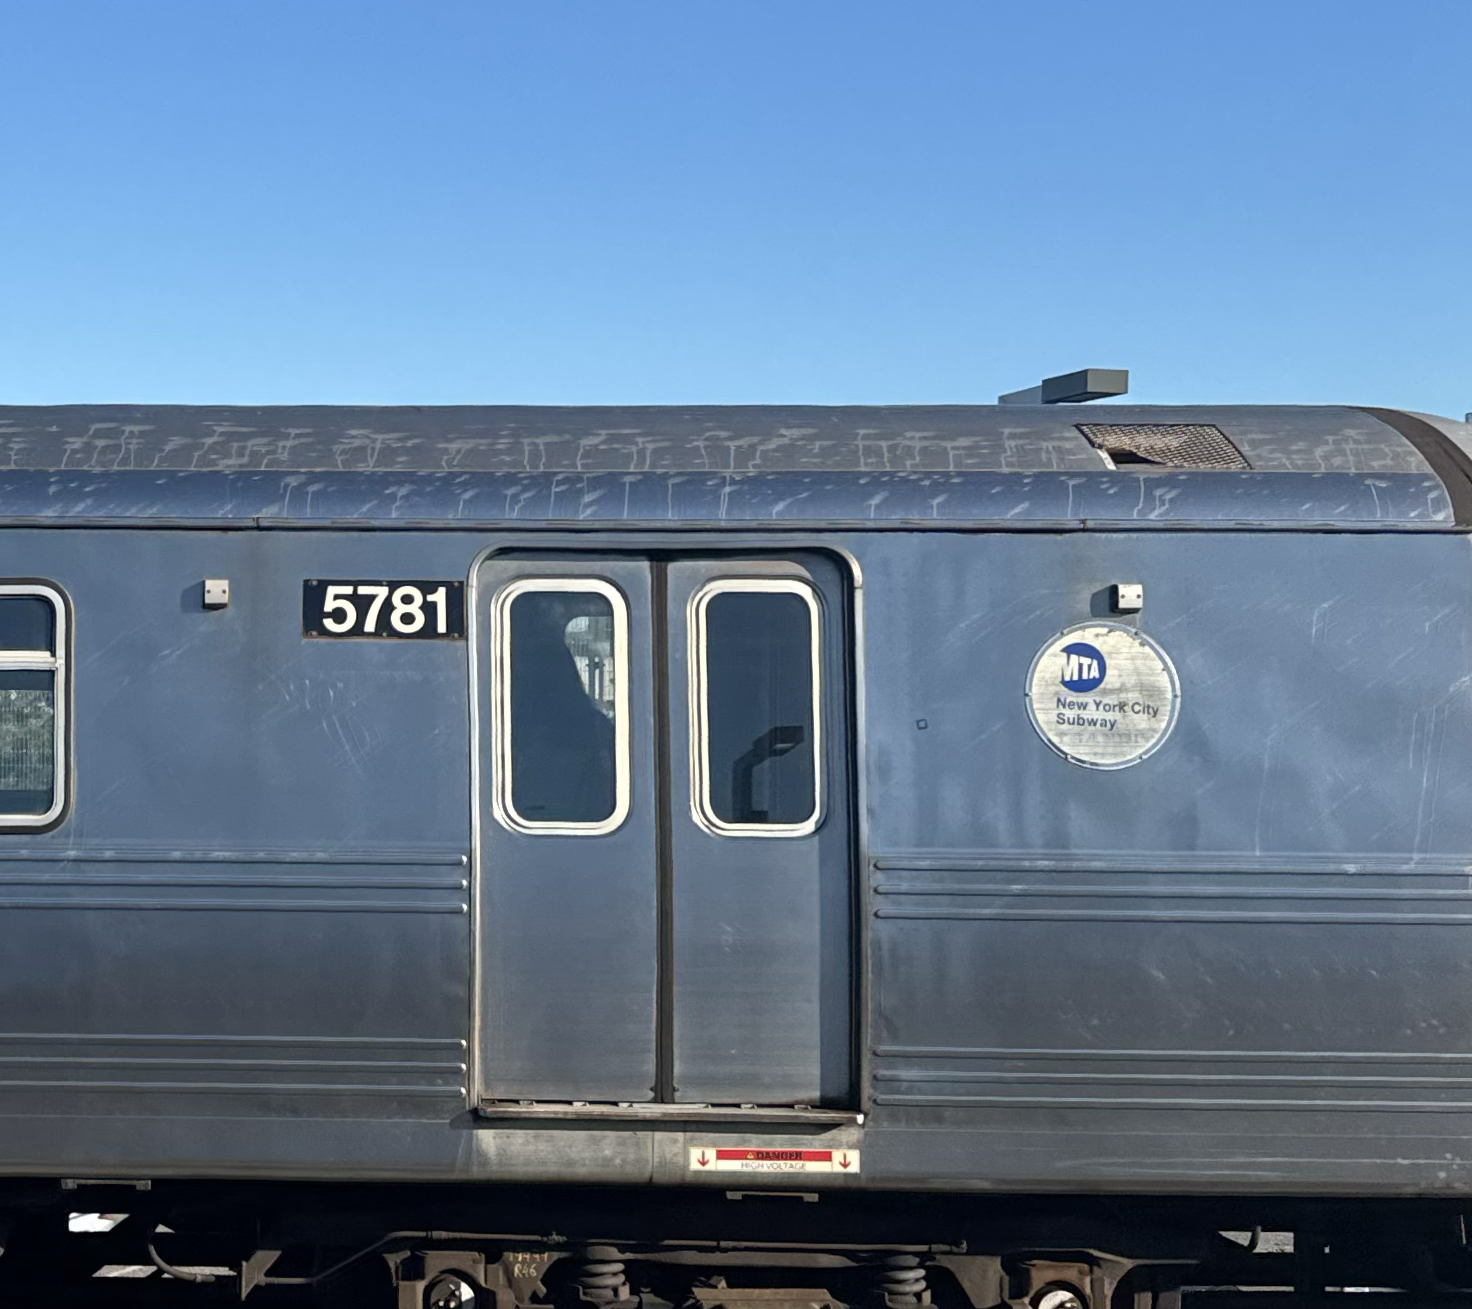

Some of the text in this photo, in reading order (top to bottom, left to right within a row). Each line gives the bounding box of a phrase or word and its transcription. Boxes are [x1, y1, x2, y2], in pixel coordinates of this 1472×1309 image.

[322, 585, 447, 634] 5781
[1061, 652, 1100, 682] MTA
[1056, 697, 1159, 718] New York City
[1056, 713, 1117, 731] Subway
[756, 1151, 803, 1160] DANGER
[741, 1161, 807, 1171] HIGH VOLTAGE
[514, 1263, 537, 1279] R46
